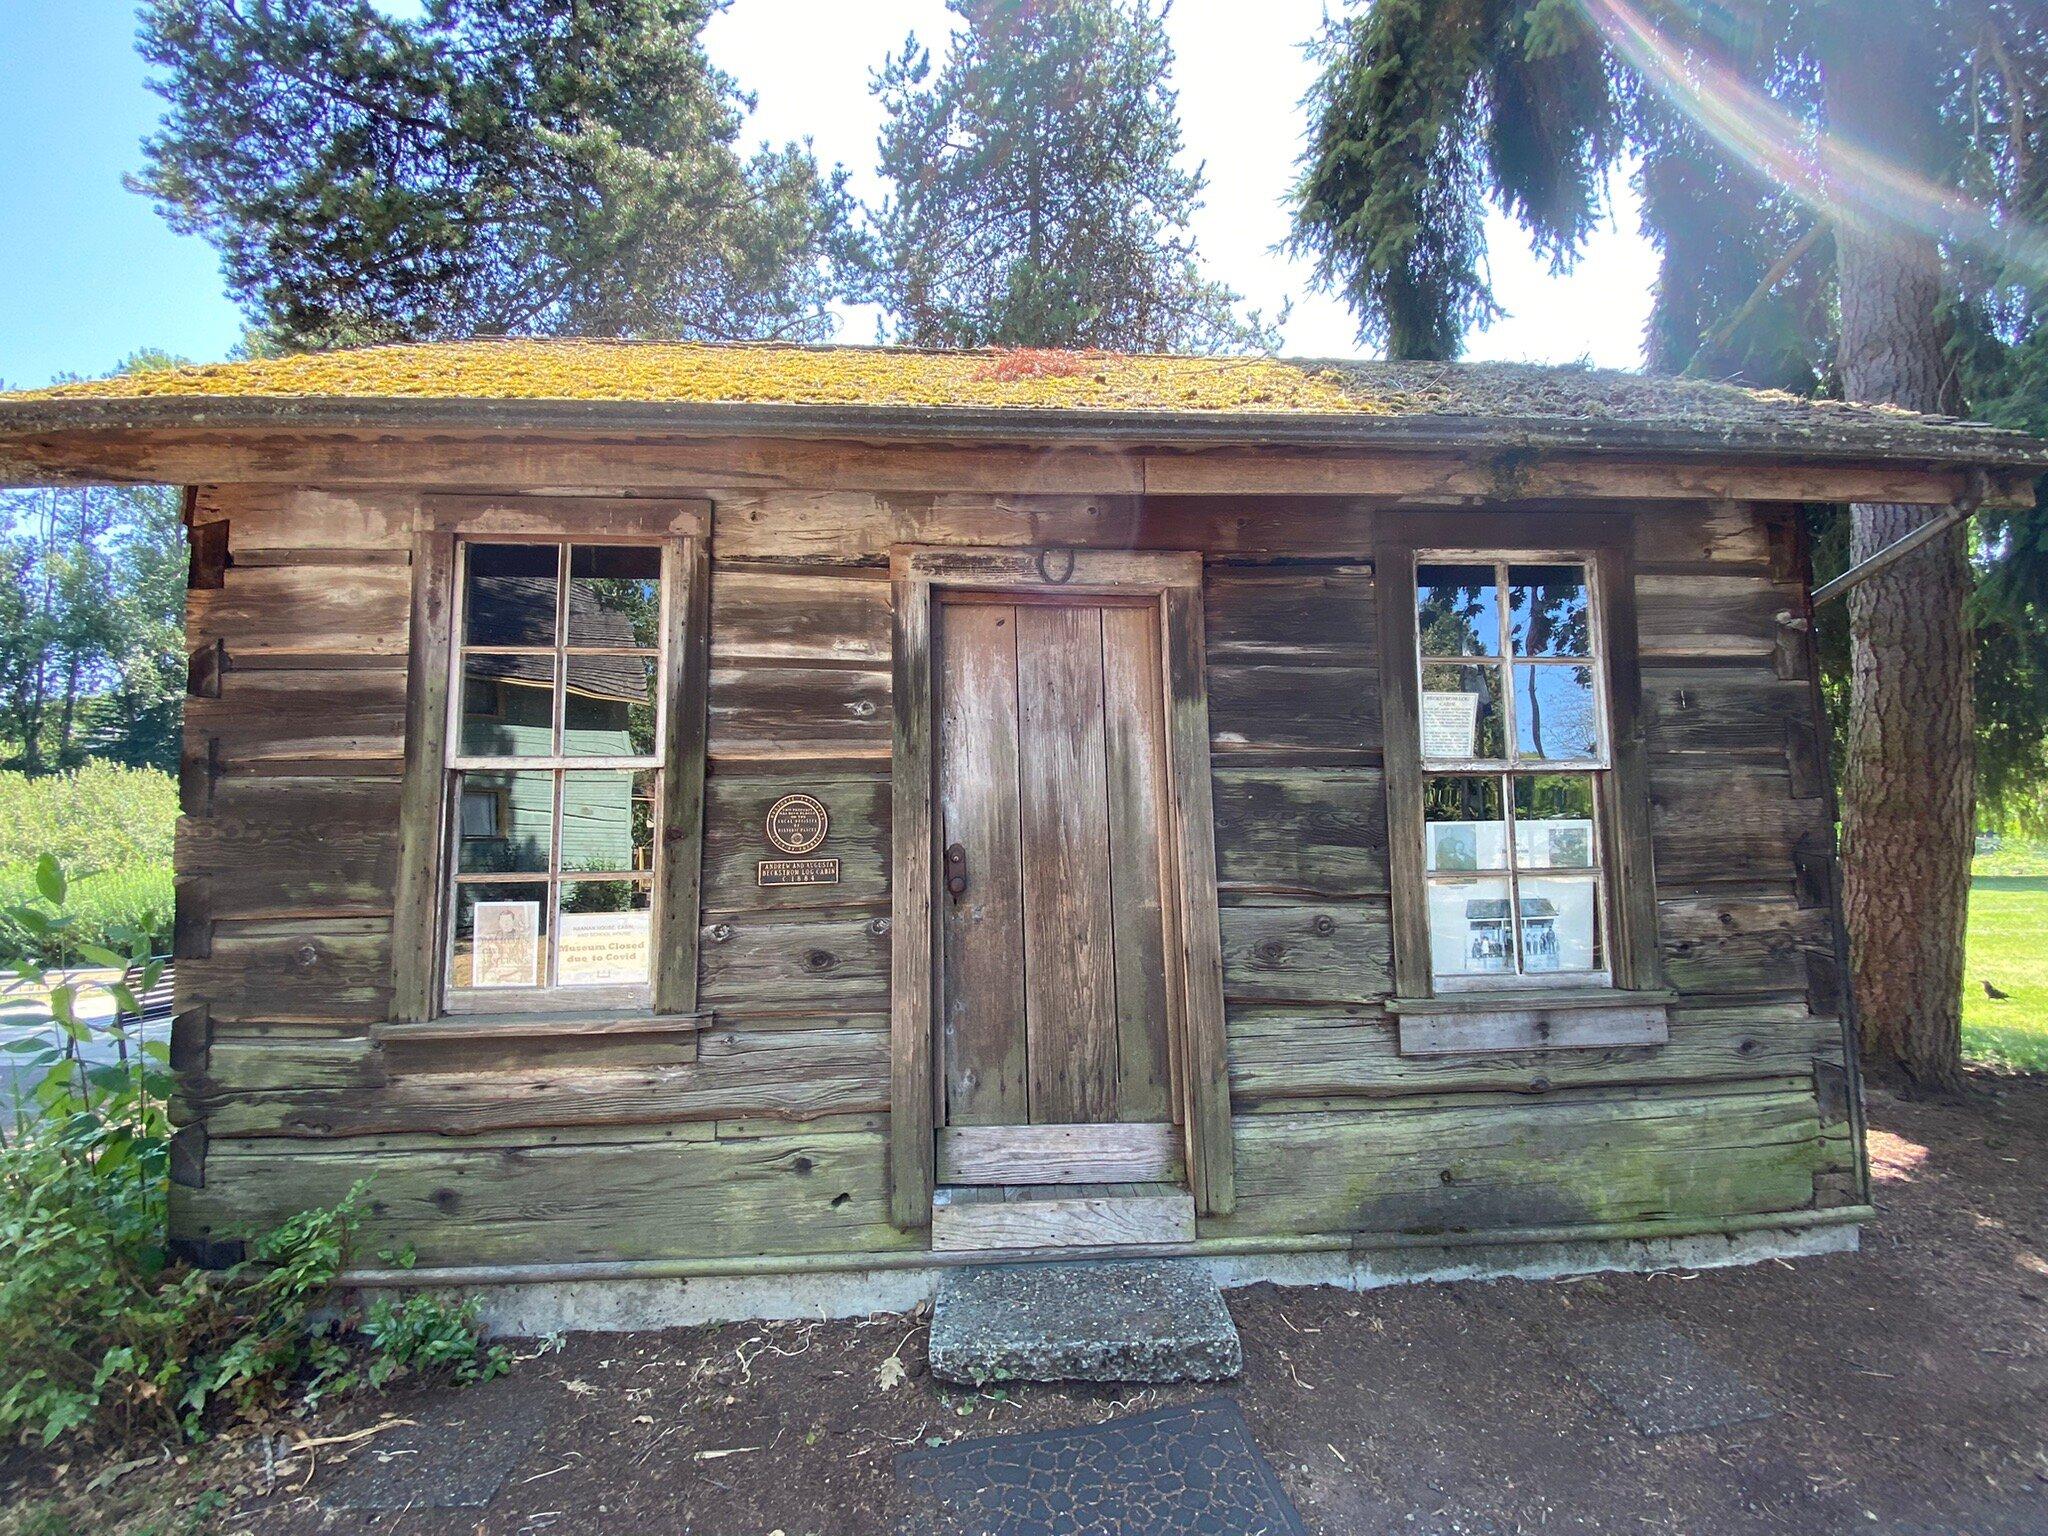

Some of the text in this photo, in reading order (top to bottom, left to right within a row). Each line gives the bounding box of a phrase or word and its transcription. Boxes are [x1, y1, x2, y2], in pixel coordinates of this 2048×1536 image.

[559, 941, 645, 953] Museum Closed
[567, 955, 588, 963] due
[606, 953, 637, 961] Covid
